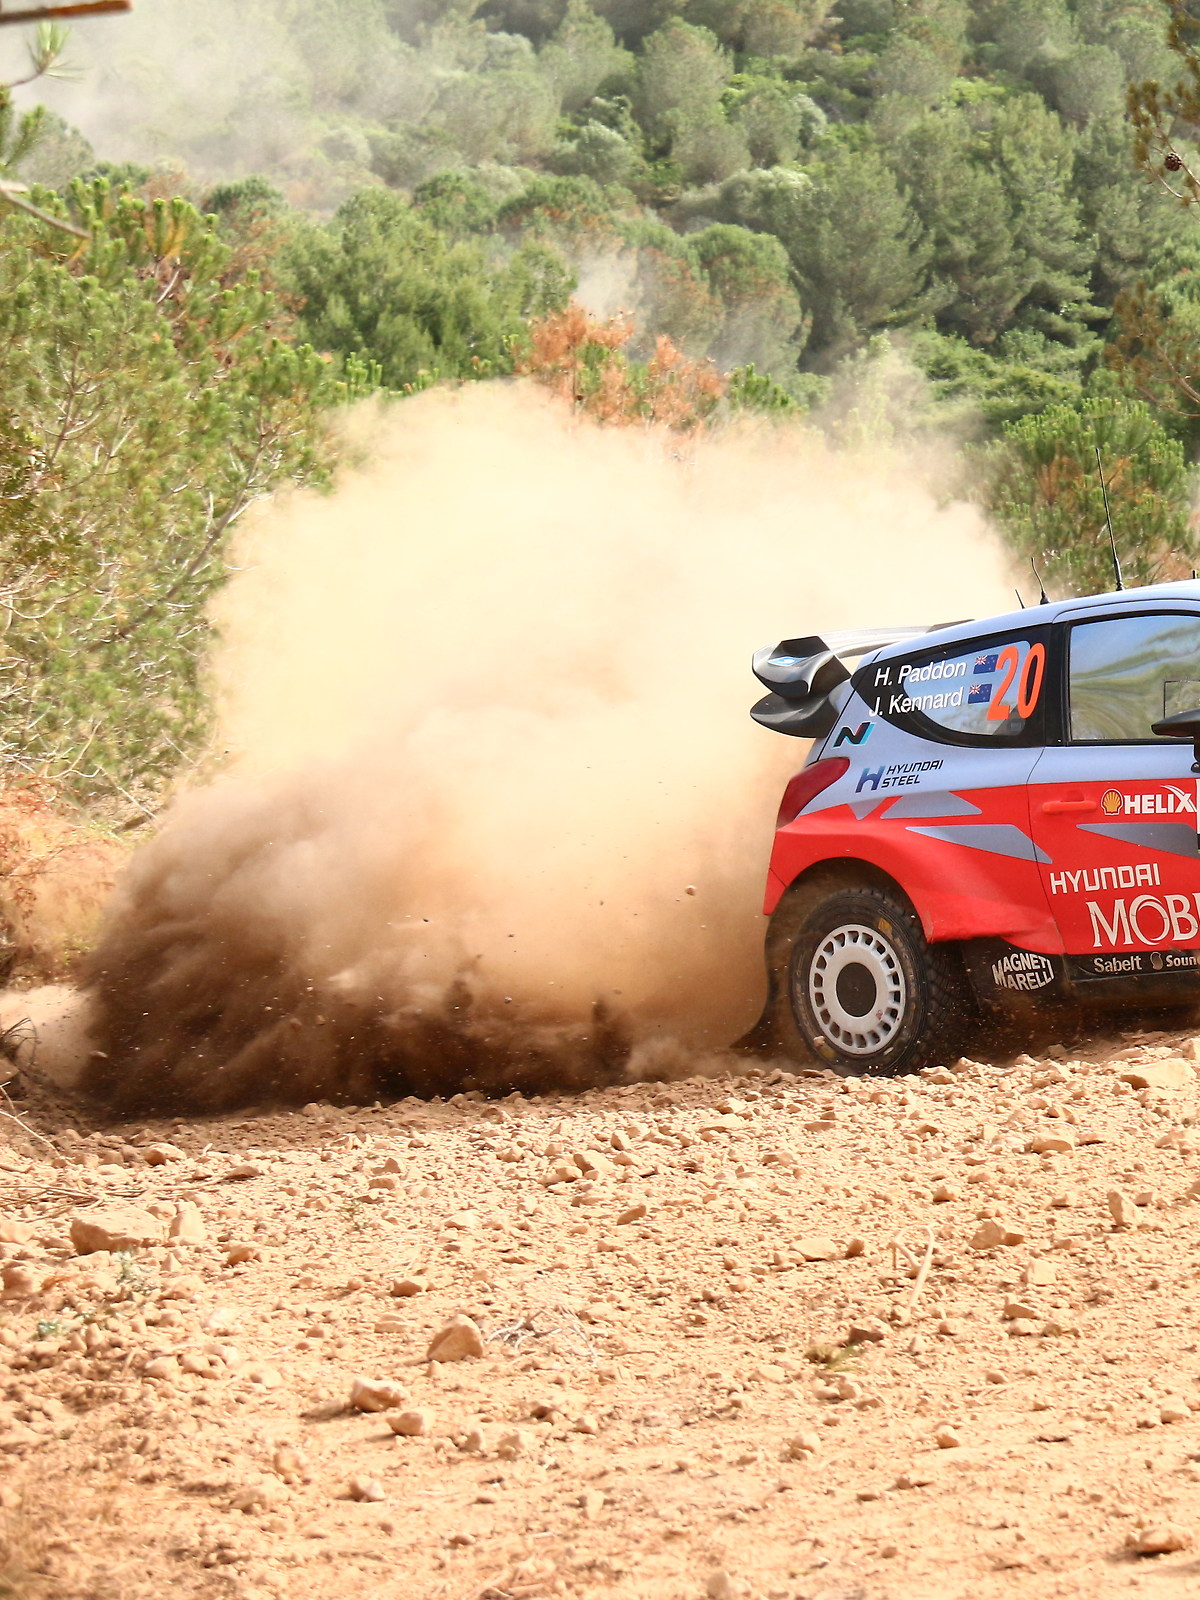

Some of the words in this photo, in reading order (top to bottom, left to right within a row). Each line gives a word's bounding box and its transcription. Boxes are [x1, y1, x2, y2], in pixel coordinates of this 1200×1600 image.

[874, 666, 893, 687] H.
[897, 660, 967, 684] Paddon
[986, 642, 1046, 721] 20
[868, 697, 884, 717] J.
[889, 687, 964, 715] Kennard
[886, 759, 944, 776] HYUNDAI
[881, 774, 921, 789] STEEL
[1123, 785, 1197, 814] HELIX
[1050, 863, 1162, 895] HYUNDAI
[991, 952, 1054, 979] MAGNETI
[1093, 955, 1143, 973] Sabelt
[992, 967, 1054, 990] MARELLI
